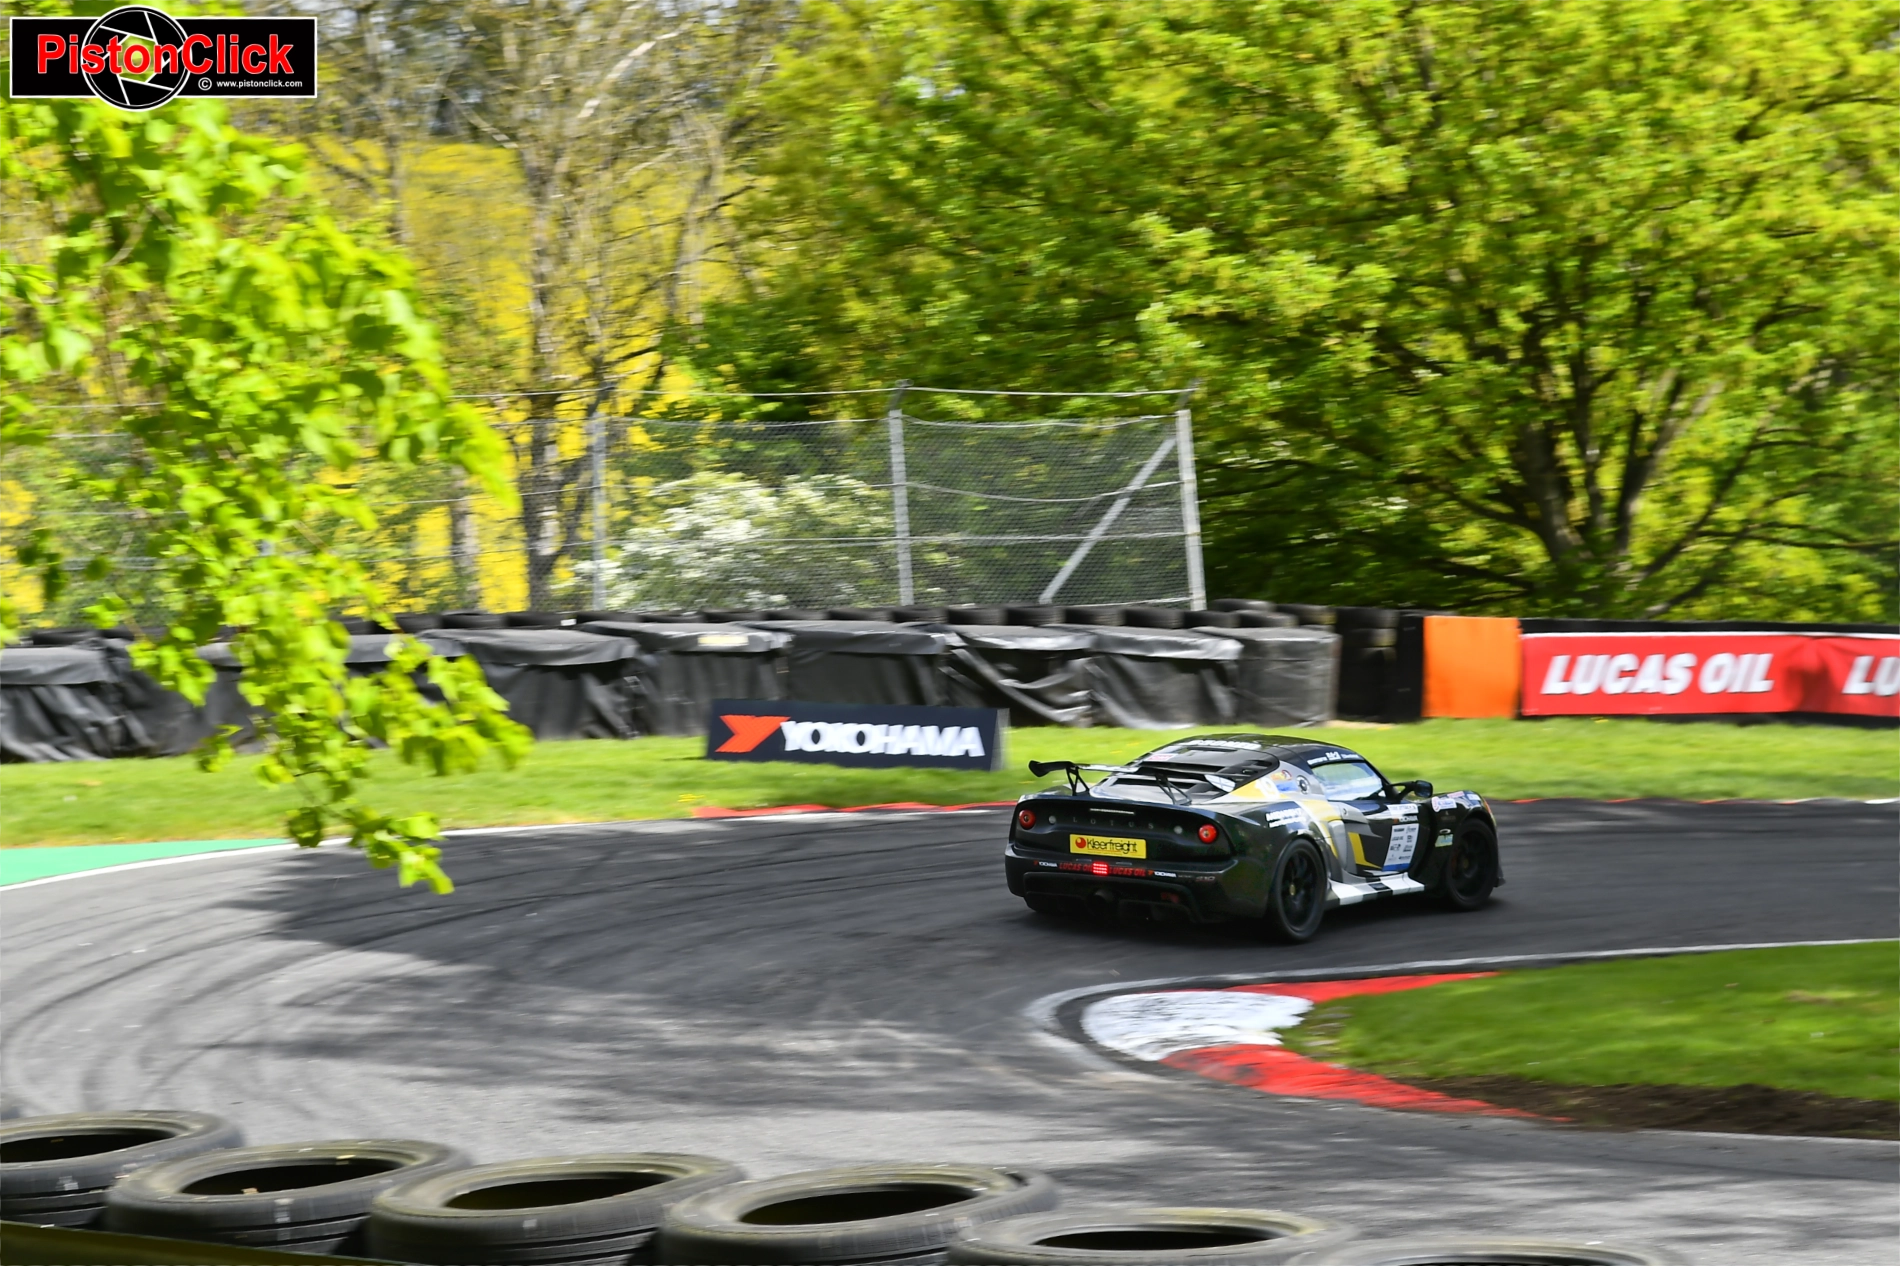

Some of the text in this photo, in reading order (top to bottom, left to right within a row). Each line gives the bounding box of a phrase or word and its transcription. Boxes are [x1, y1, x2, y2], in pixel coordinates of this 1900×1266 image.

[1540, 653, 1774, 695] LUCAS OIL
[780, 720, 985, 757] YOKOHAMA
[1073, 816, 1153, 829] LOTUS
